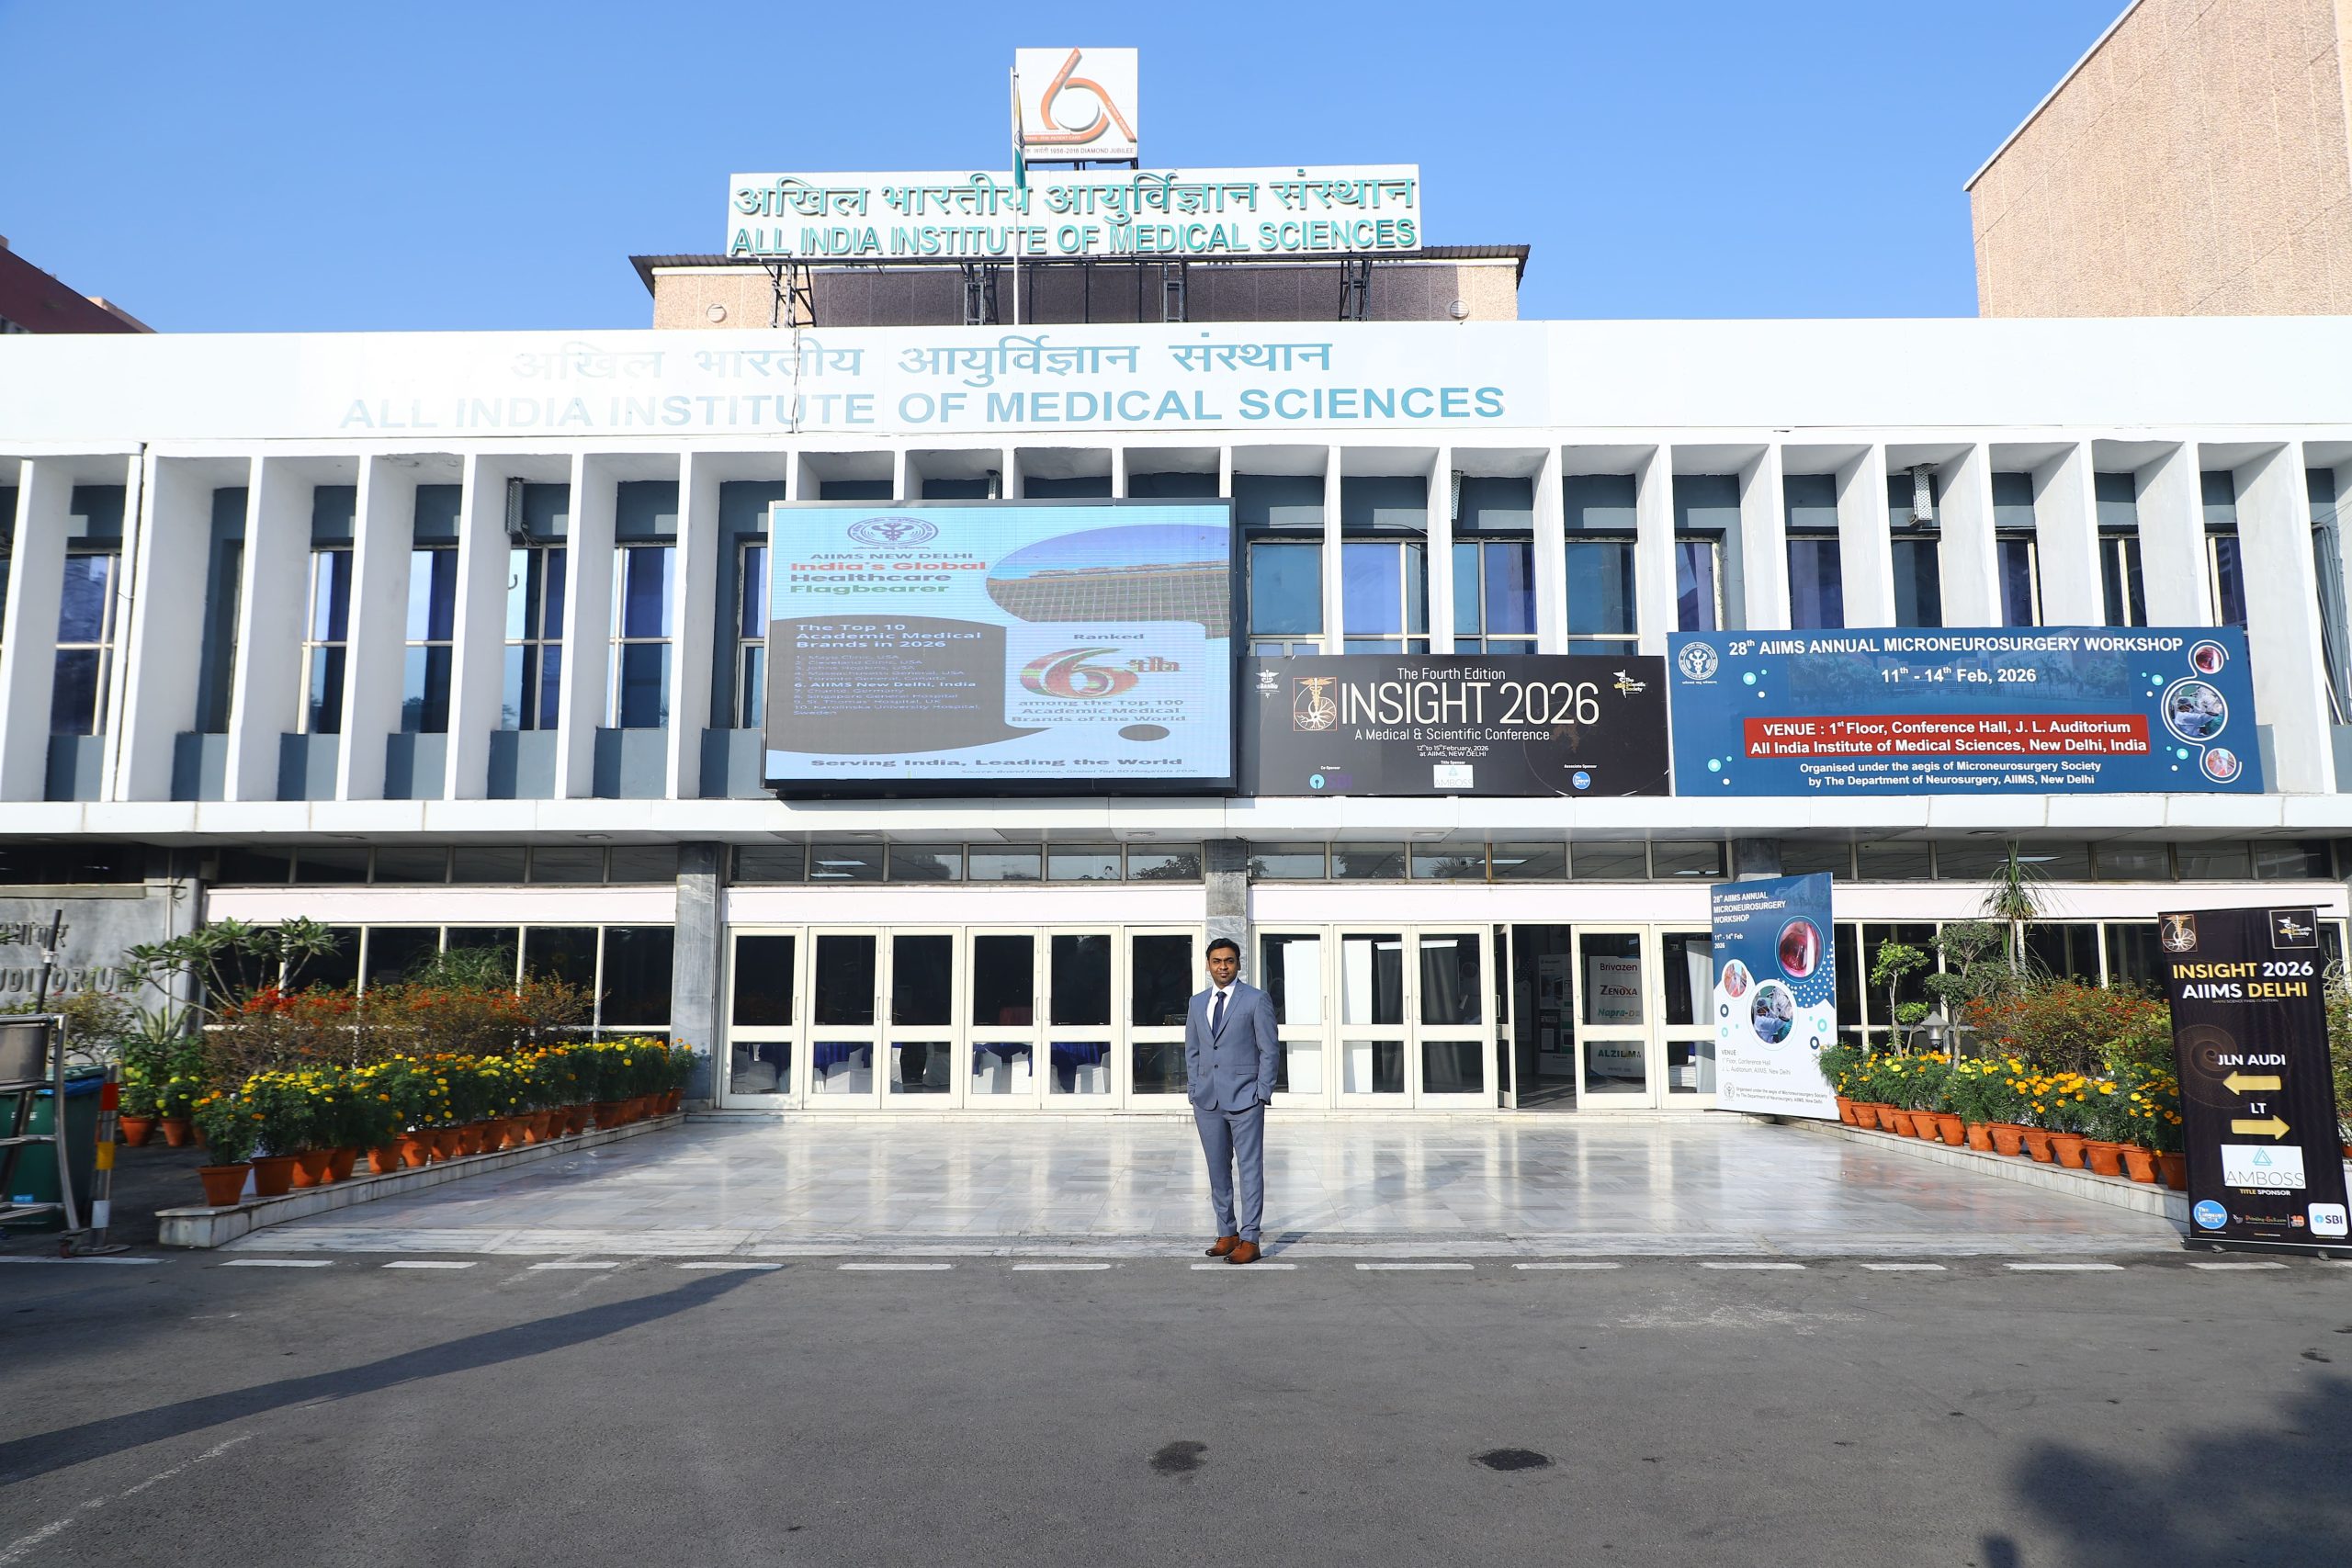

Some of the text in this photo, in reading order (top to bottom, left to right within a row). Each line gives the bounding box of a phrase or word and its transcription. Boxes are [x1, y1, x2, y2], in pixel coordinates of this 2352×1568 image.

[734, 169, 1416, 225] अखिल भारतीय आयुर्विज्ञान संस्थान
[730, 218, 1416, 255] ALL INDIA INSTITUTE OF MEDICAL SCIENCES
[511, 333, 1333, 388] अखिल भारतीय आयुर्विज्ञान संस्थान
[339, 387, 1506, 430] ALL INDIA INSTITUTE OF MEDICAL SCIENCES
[790, 561, 986, 571] India's Global
[790, 573, 952, 582] Healthcare
[790, 585, 950, 595] Flagbearer
[1729, 637, 2183, 656] 28th AIIMS ANNUAL MICRONEUROSURGERY WORKSHOP
[1397, 667, 1506, 680] The Fourth Edition
[1882, 667, 2037, 684] 11th 14th Feb, 2026
[1341, 682, 1600, 725] INSIGHT 2026
[1355, 728, 1550, 741] A Medical & Scientific Conference
[1763, 720, 2131, 737] VENUE 1st Floor, Conference Hall, J. L. Auditorium
[1751, 739, 2147, 755] All India Institute of Medical Sciences, New Delhi, India
[810, 759, 897, 768] Serving
[904, 759, 967, 767] India,
[975, 759, 1067, 767] Leading
[1800, 761, 2102, 775] Organised under the aegis of Microneurosurgery Society
[1808, 775, 2095, 788] by The Department of Neurosurgery, AIIMS, New Delhi
[1724, 894, 1741, 902] AIIMS
[1742, 891, 1769, 901] ANNUAL
[1713, 900, 1786, 913] MICRONEUROSURGERY
[1713, 914, 1750, 924] WORKSHOP
[1600, 963, 1637, 971] Brivazen
[2172, 961, 2314, 979] INSIGHT 2026
[2182, 981, 2308, 999] AIIMS DELHI
[2217, 1055, 2286, 1066] JLN AUDI
[2250, 1102, 2267, 1114] LT
[2225, 1170, 2305, 1187] AMBOSS
[2324, 1214, 2343, 1224] SBI
